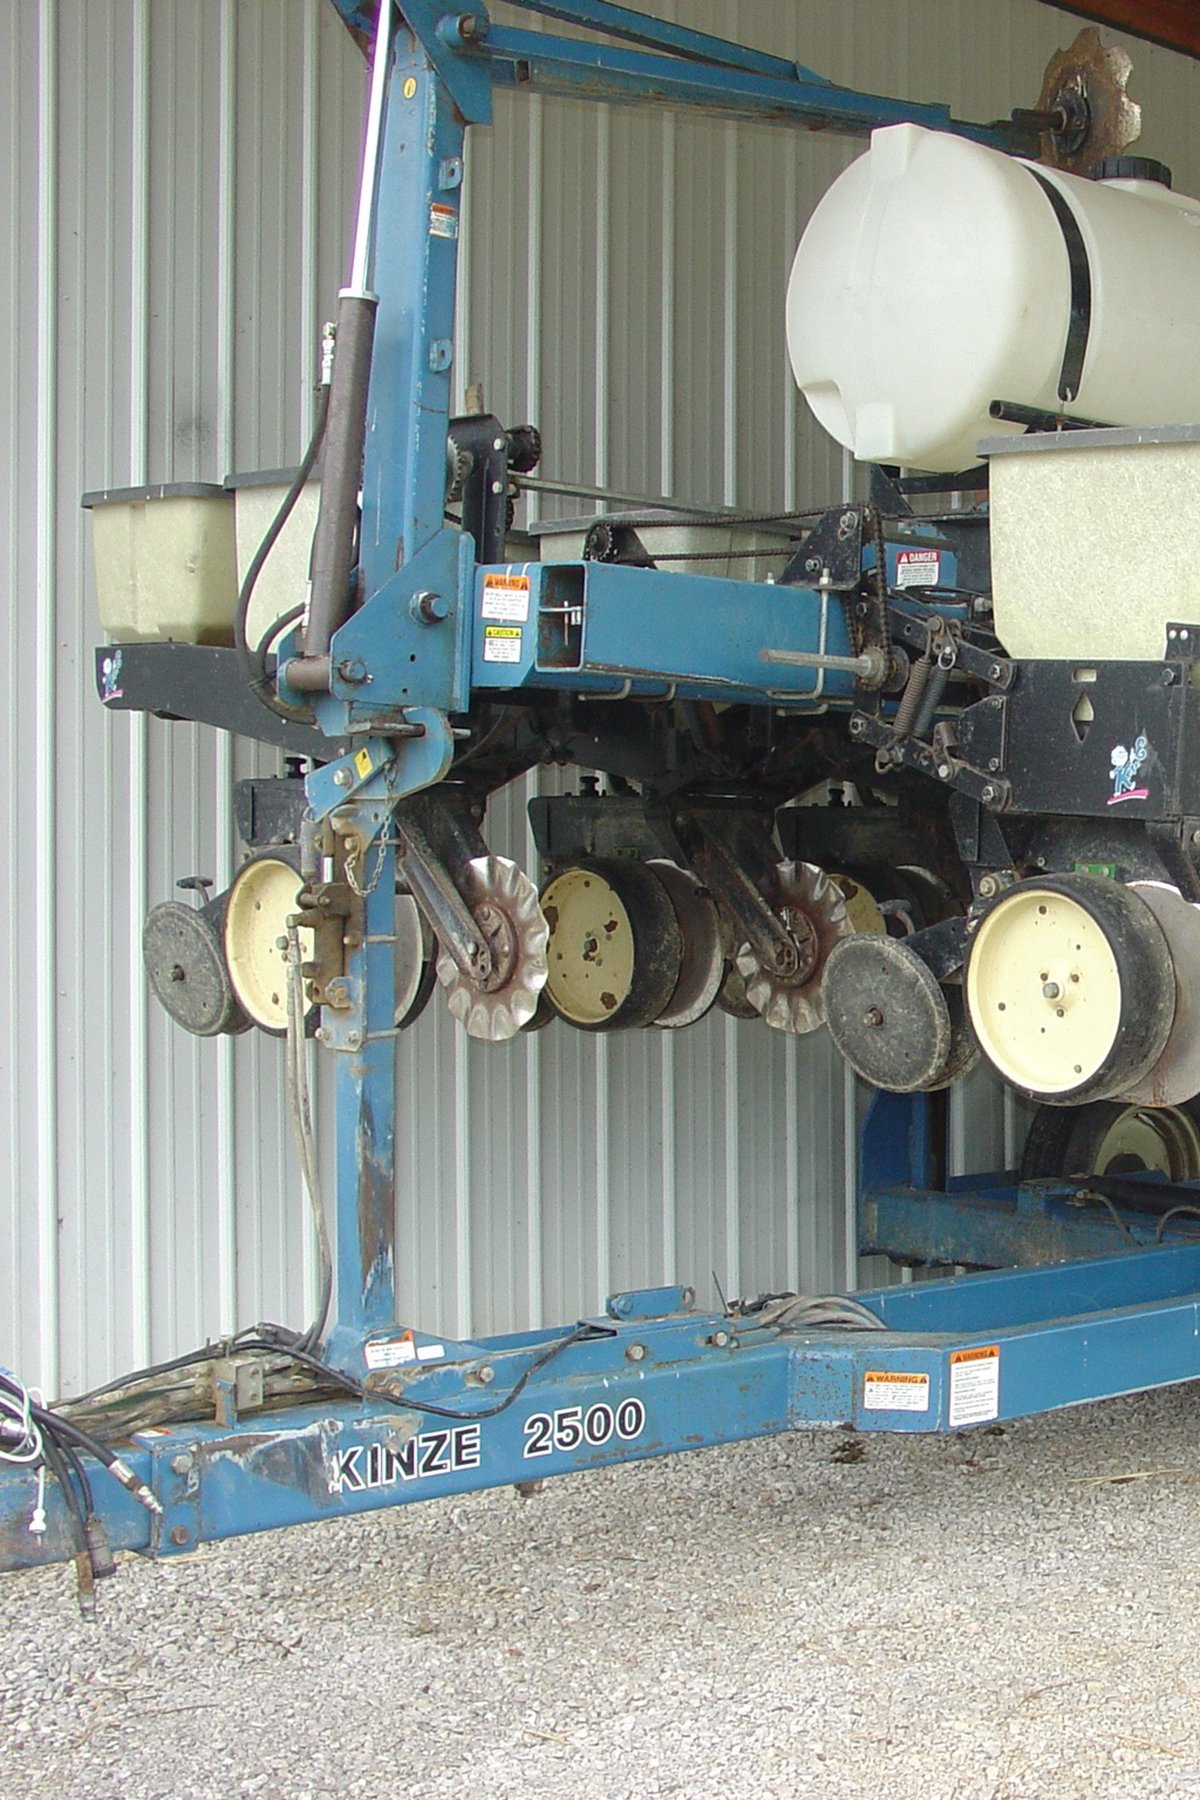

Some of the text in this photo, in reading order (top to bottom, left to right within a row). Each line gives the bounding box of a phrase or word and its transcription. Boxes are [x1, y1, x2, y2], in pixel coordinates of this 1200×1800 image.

[908, 552, 937, 562] DANGER
[492, 628, 514, 636] CAUTION
[875, 1375, 919, 1384] WARNING
[330, 1398, 646, 1493] KINZE 2500
